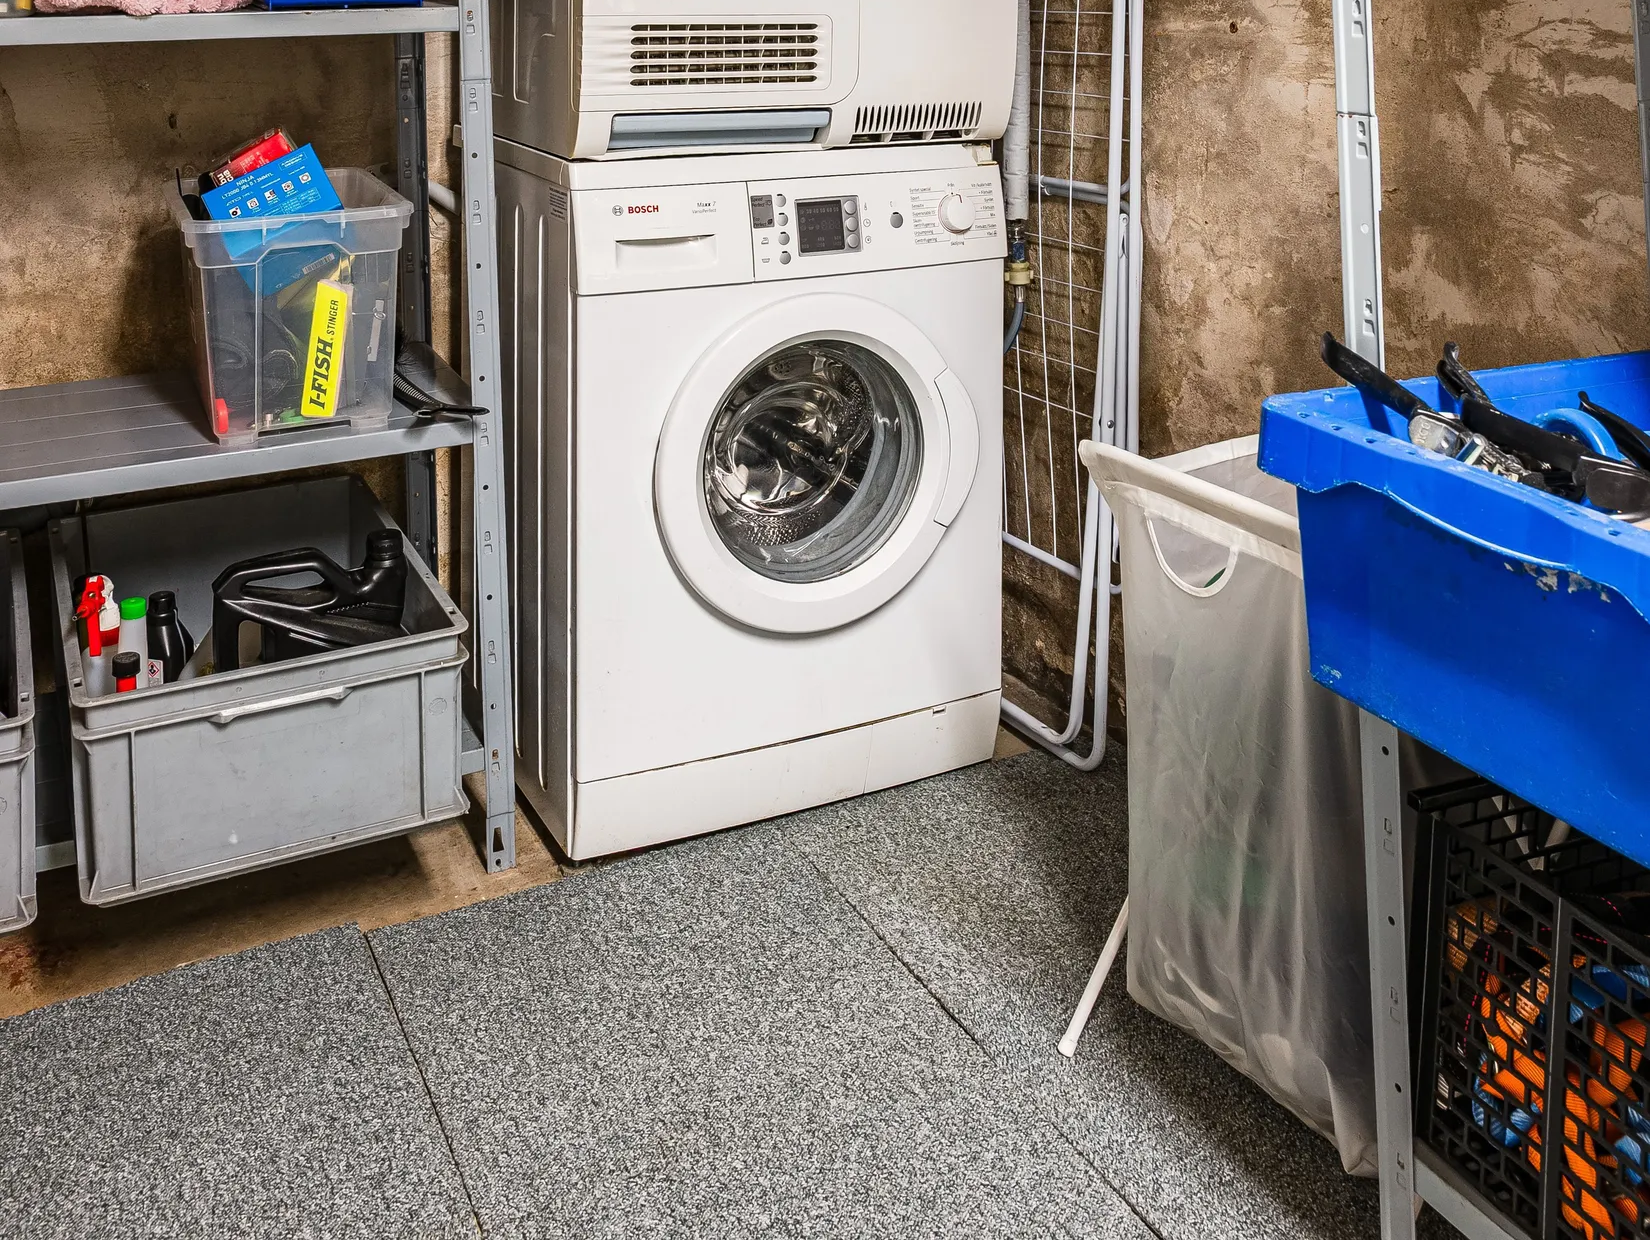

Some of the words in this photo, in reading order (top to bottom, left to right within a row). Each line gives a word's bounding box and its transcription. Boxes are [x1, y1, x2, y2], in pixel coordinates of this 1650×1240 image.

[627, 205, 659, 214] BOSCH
[309, 336, 334, 410] I-FISH
[326, 299, 339, 336] STINGER
